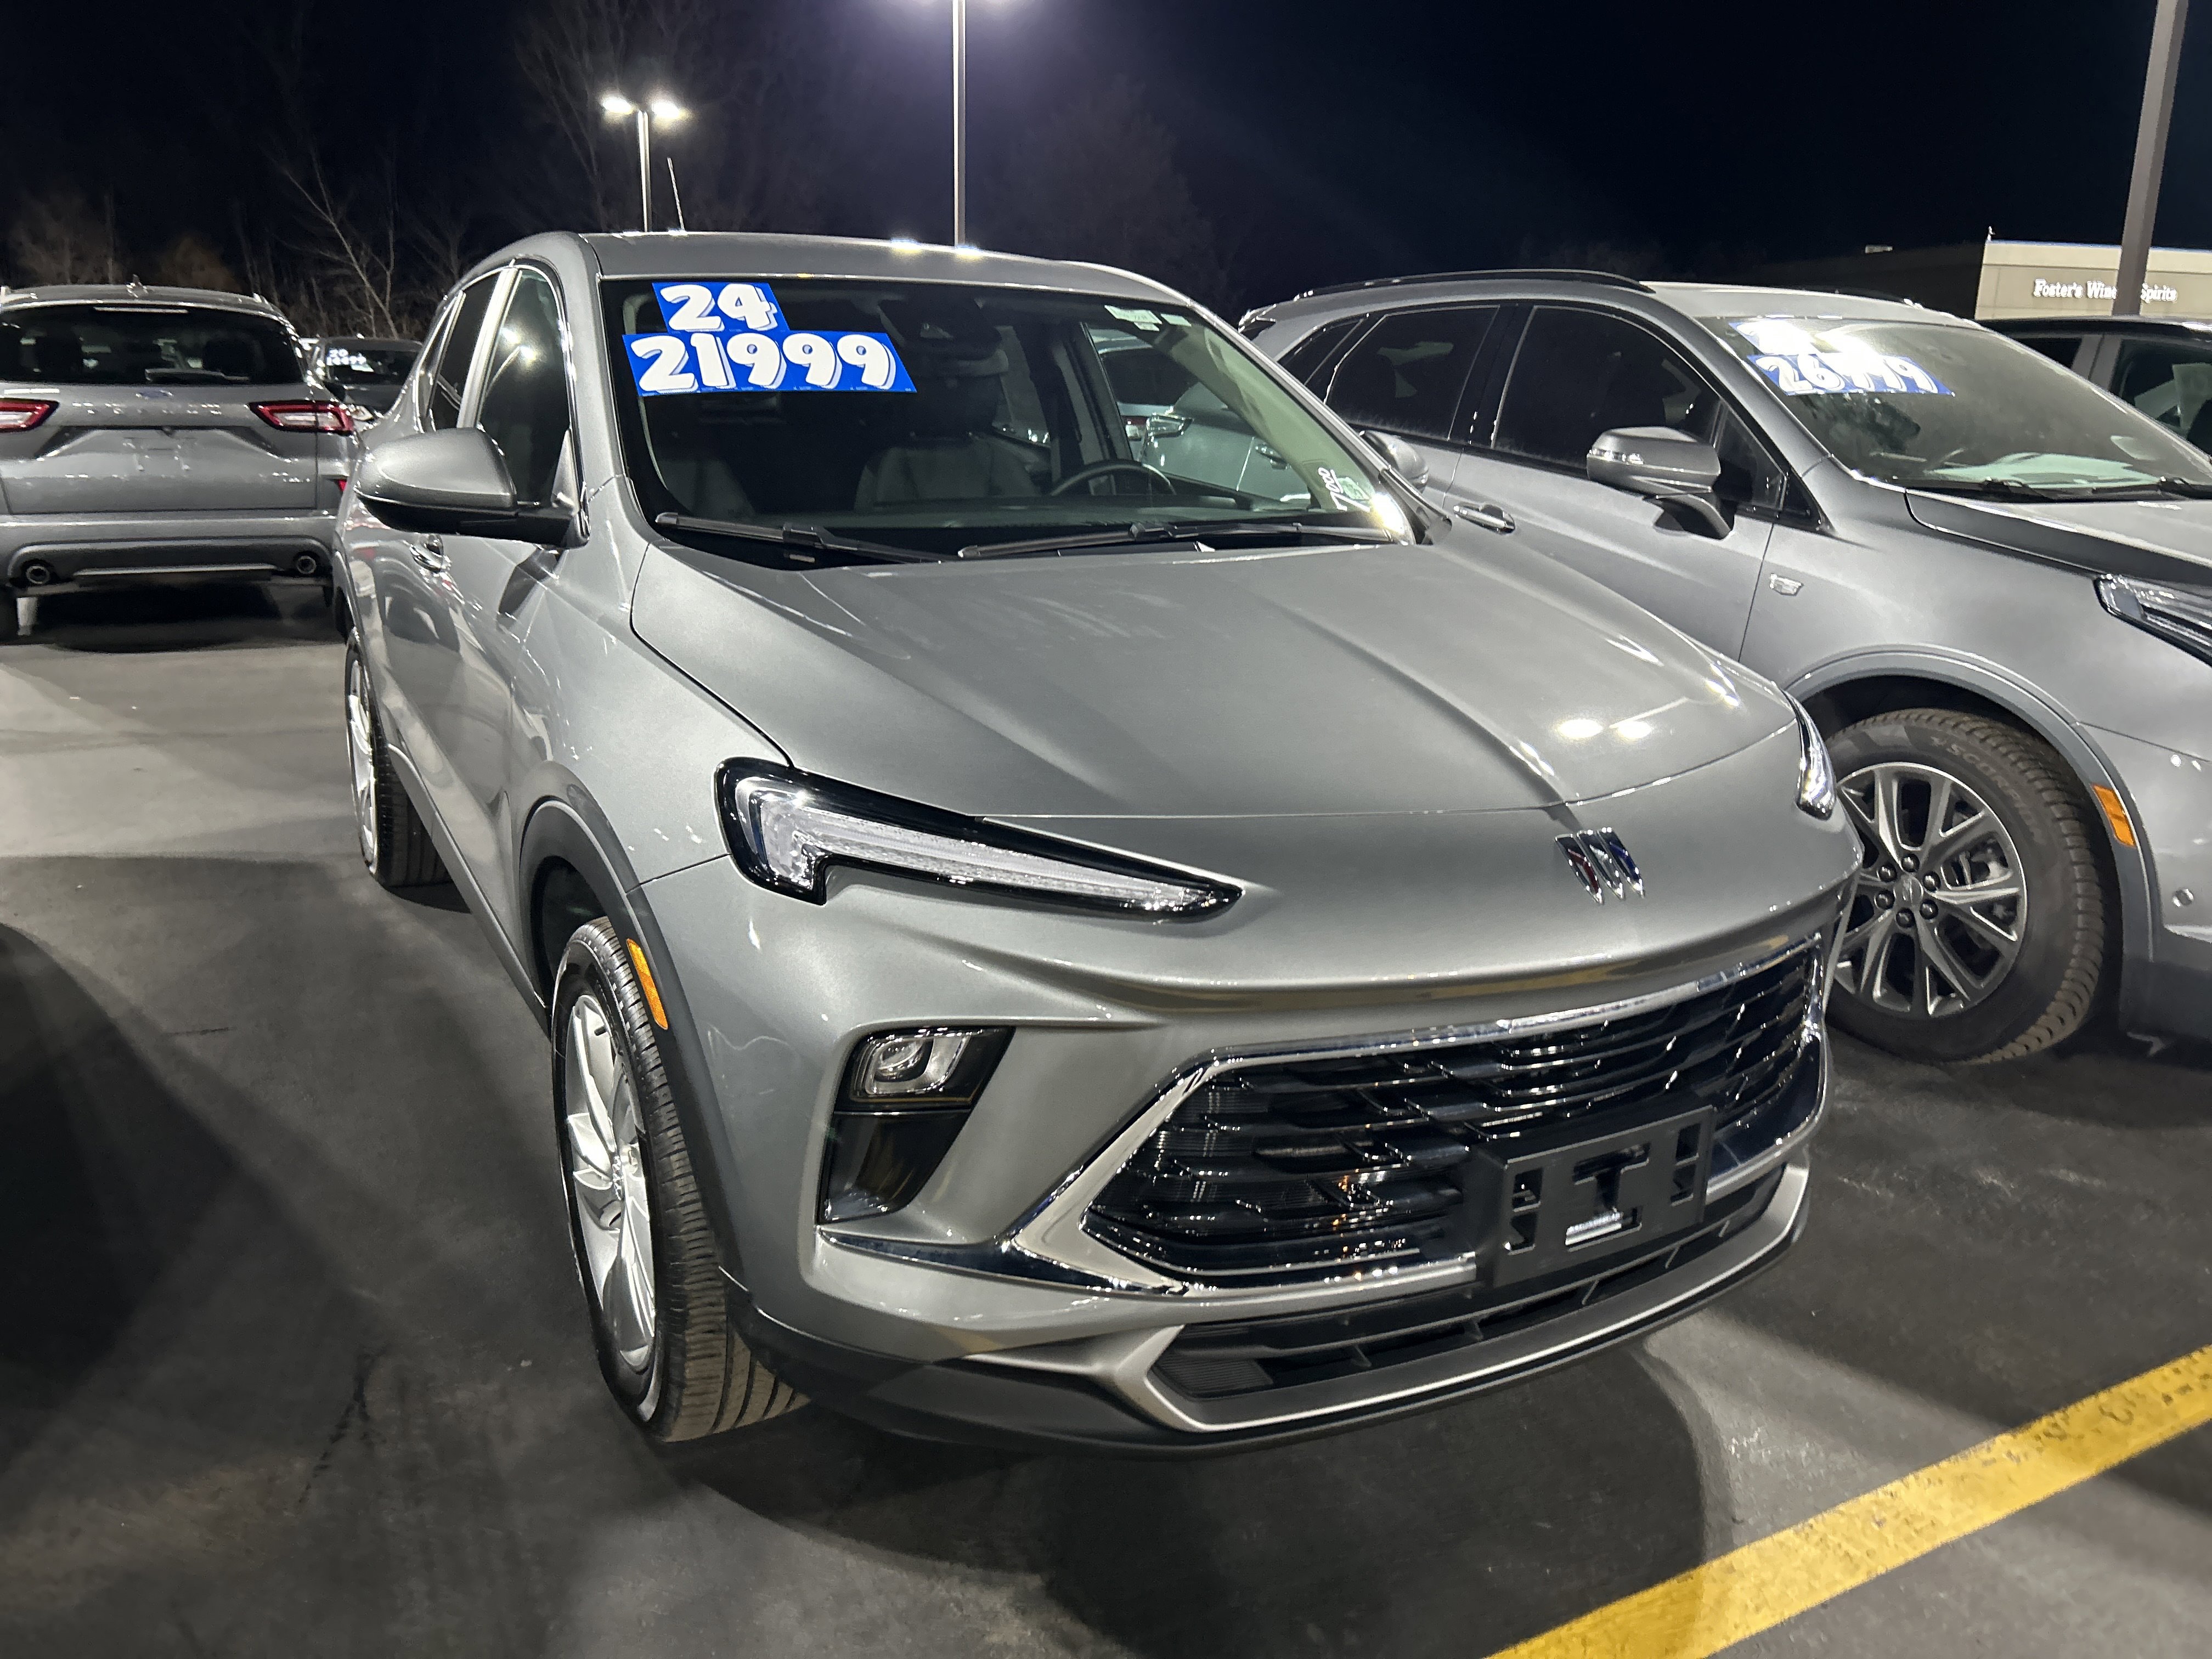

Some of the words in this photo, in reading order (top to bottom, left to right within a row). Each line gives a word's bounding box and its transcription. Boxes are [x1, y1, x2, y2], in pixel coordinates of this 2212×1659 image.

[660, 283, 777, 331] 24
[2033, 279, 2083, 298] Foster's
[630, 332, 896, 393] 21999
